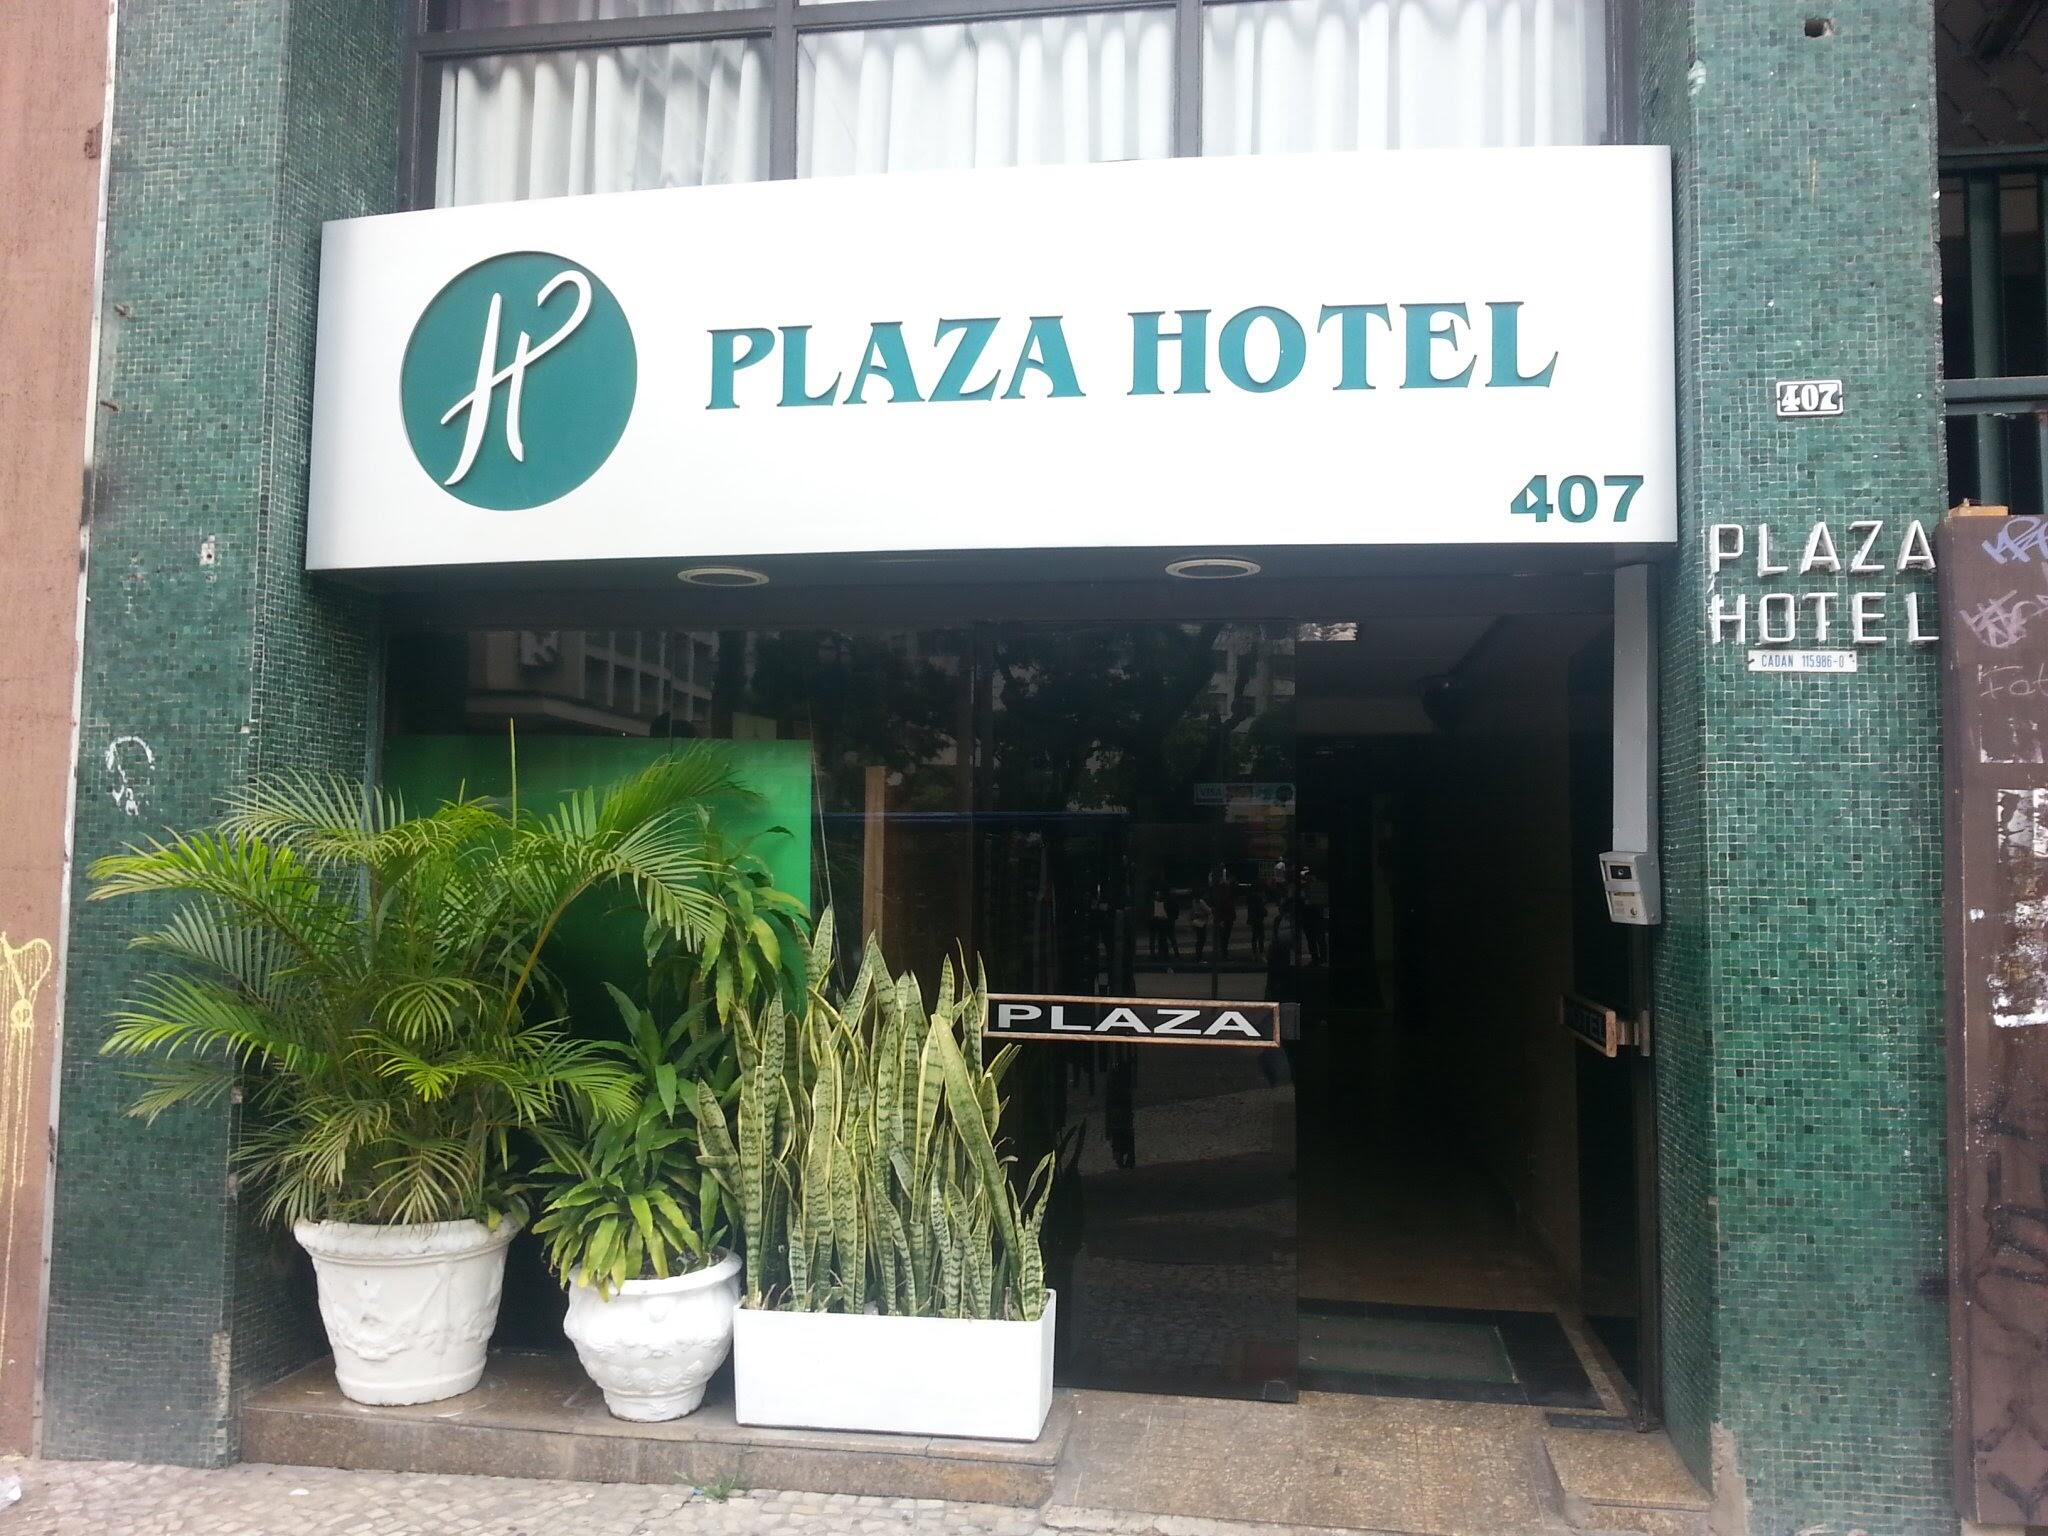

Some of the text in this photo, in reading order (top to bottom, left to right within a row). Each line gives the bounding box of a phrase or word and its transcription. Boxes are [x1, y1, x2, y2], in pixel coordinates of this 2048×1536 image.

[704, 301, 1559, 410] PLAZA HOTEL
[1780, 384, 1840, 412] 407
[1510, 474, 1645, 523] 407
[1709, 519, 1937, 575] PLAZA
[1709, 592, 1940, 646] HOTEL
[1761, 654, 1794, 668] CADAN
[998, 1003, 1262, 1038] PLAZA
